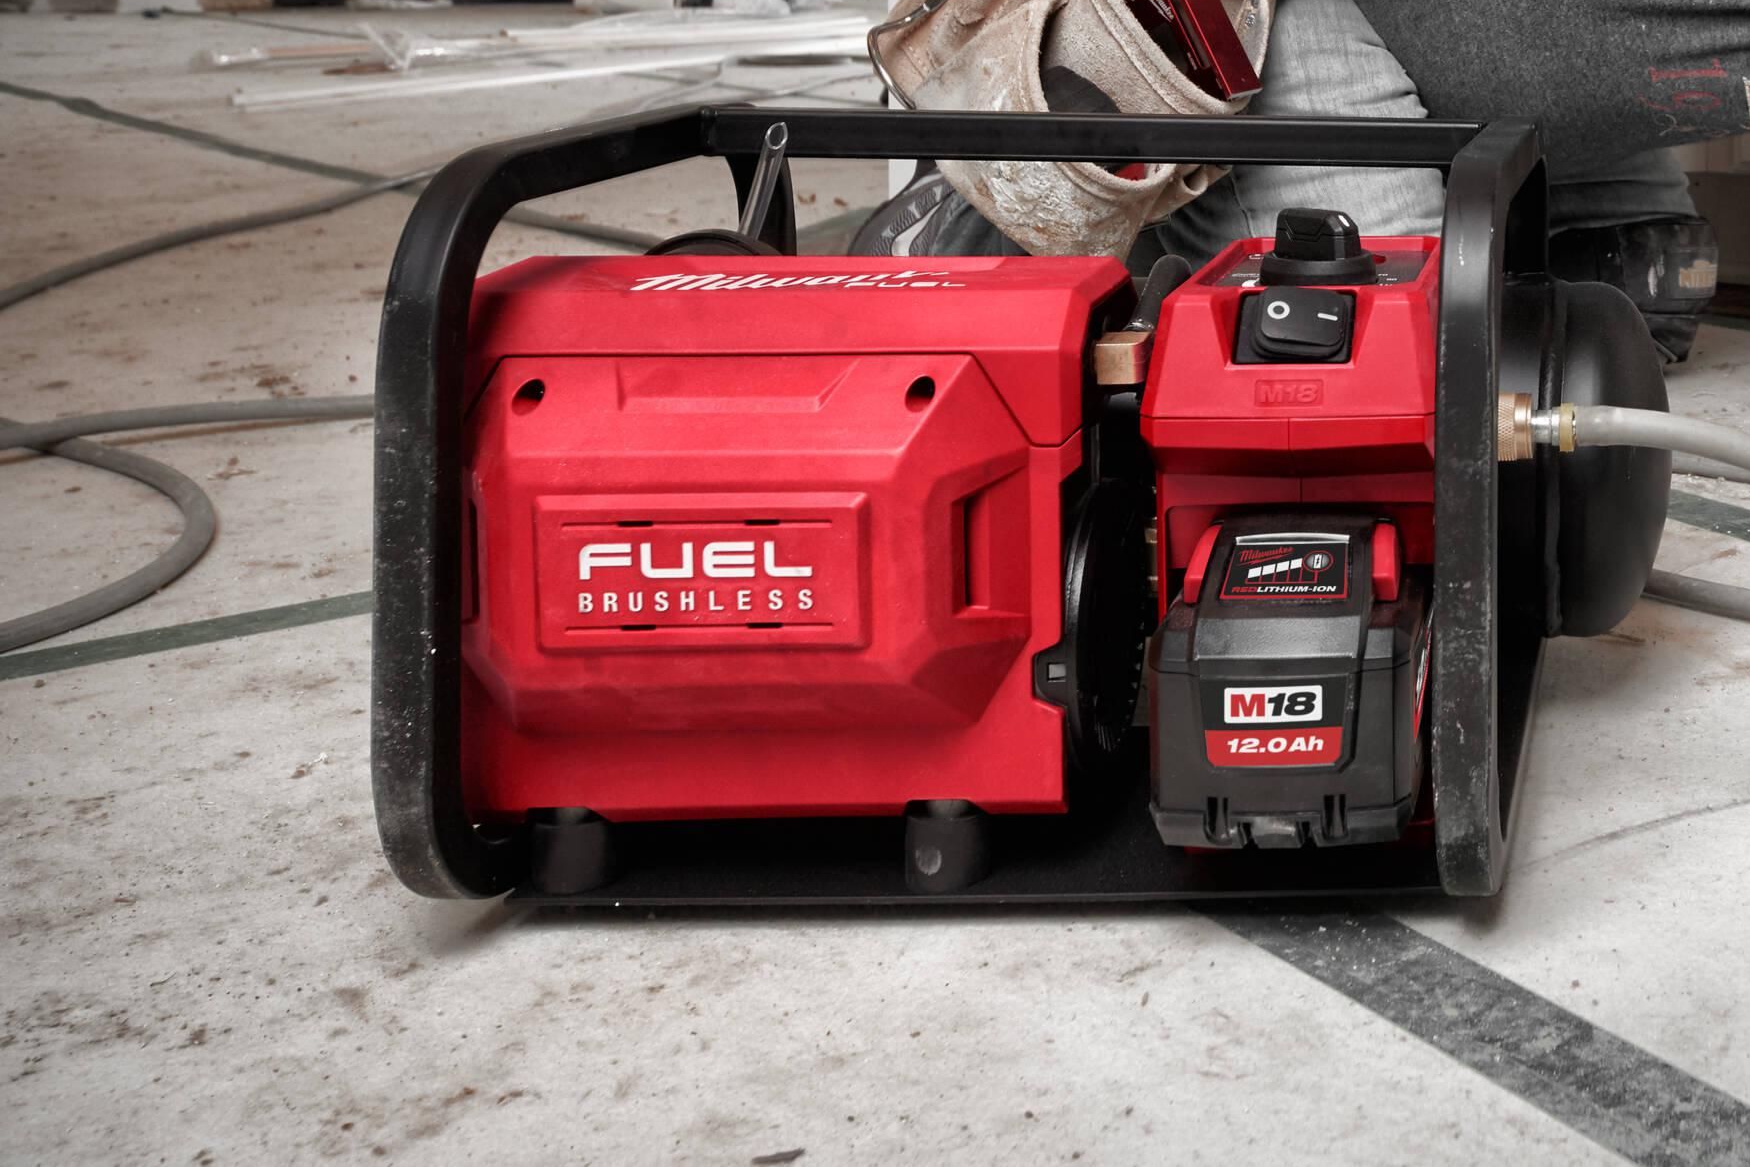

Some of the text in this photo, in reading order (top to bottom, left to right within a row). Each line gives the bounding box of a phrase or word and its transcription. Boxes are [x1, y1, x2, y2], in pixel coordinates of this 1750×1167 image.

[1260, 383, 1319, 404] M18
[578, 540, 813, 581] FUEL
[1239, 546, 1295, 562] Milwaukee
[578, 588, 814, 614] BRUSHLESS
[1229, 691, 1317, 717] M18
